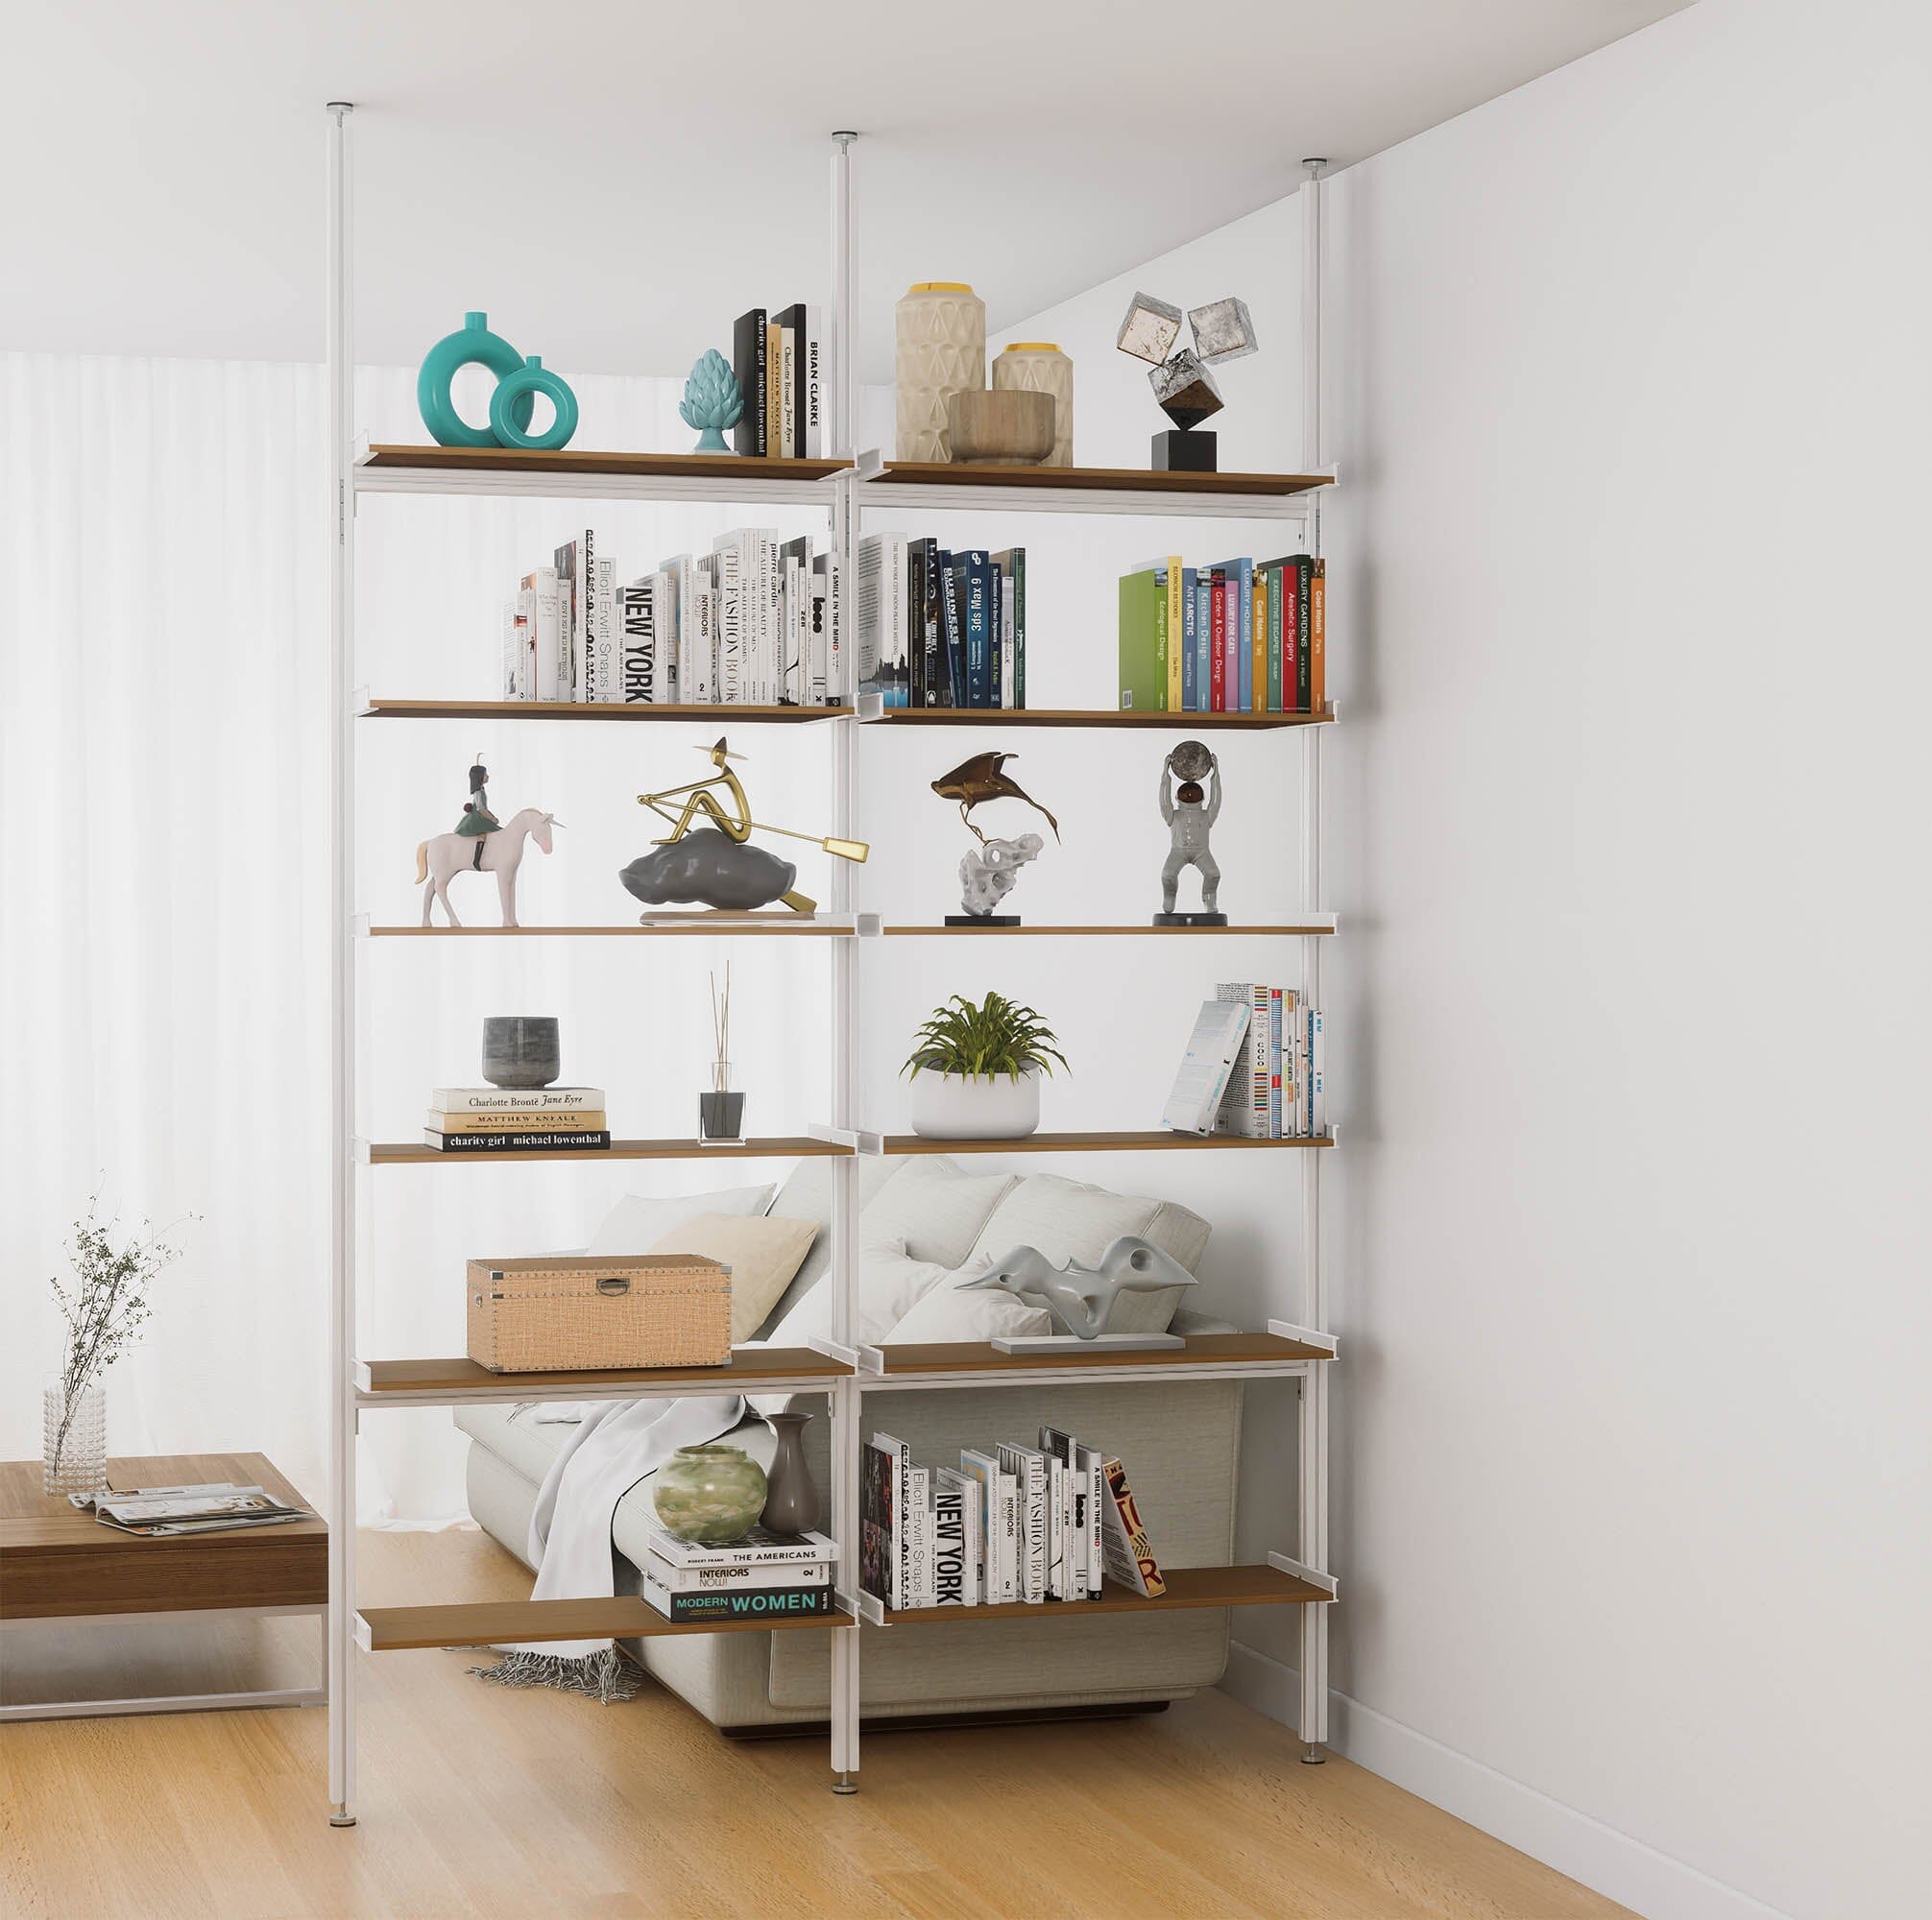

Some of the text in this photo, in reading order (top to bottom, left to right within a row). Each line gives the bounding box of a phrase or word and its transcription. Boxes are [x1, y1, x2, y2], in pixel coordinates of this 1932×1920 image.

[757, 315, 766, 453] charity girl michael lowenthal
[726, 550, 738, 585] THE
[769, 542, 778, 573] pierre
[833, 601, 839, 611] IN
[947, 568, 959, 645] BUSINESS
[972, 588, 981, 610] Max
[597, 561, 612, 688] Elliott Erwitt Snaps
[726, 587, 738, 655] FASHION
[972, 612, 981, 632] 3ds
[1200, 592, 1210, 660] Kitchen Design
[625, 588, 653, 703] NEW YORK
[1287, 629, 1295, 661] Surgery
[469, 1098, 508, 1107] Charlotte
[542, 1094, 561, 1106] Jane
[565, 1094, 583, 1106] Eyre
[450, 1134, 601, 1146] charity girl michael lowenthal
[1031, 1457, 1045, 1488] THE
[1095, 1500, 1100, 1508] IN
[910, 1473, 925, 1592] Elliott Erwitt Snaps
[1031, 1492, 1045, 1555] FASHION
[756, 1551, 816, 1561] AMERICANS
[937, 1494, 962, 1603] NEW YORK
[699, 1568, 749, 1578] INTERIORS
[699, 1578, 728, 1587] NOW!
[676, 1597, 728, 1609] MODERN
[732, 1594, 815, 1613] WOMEN
